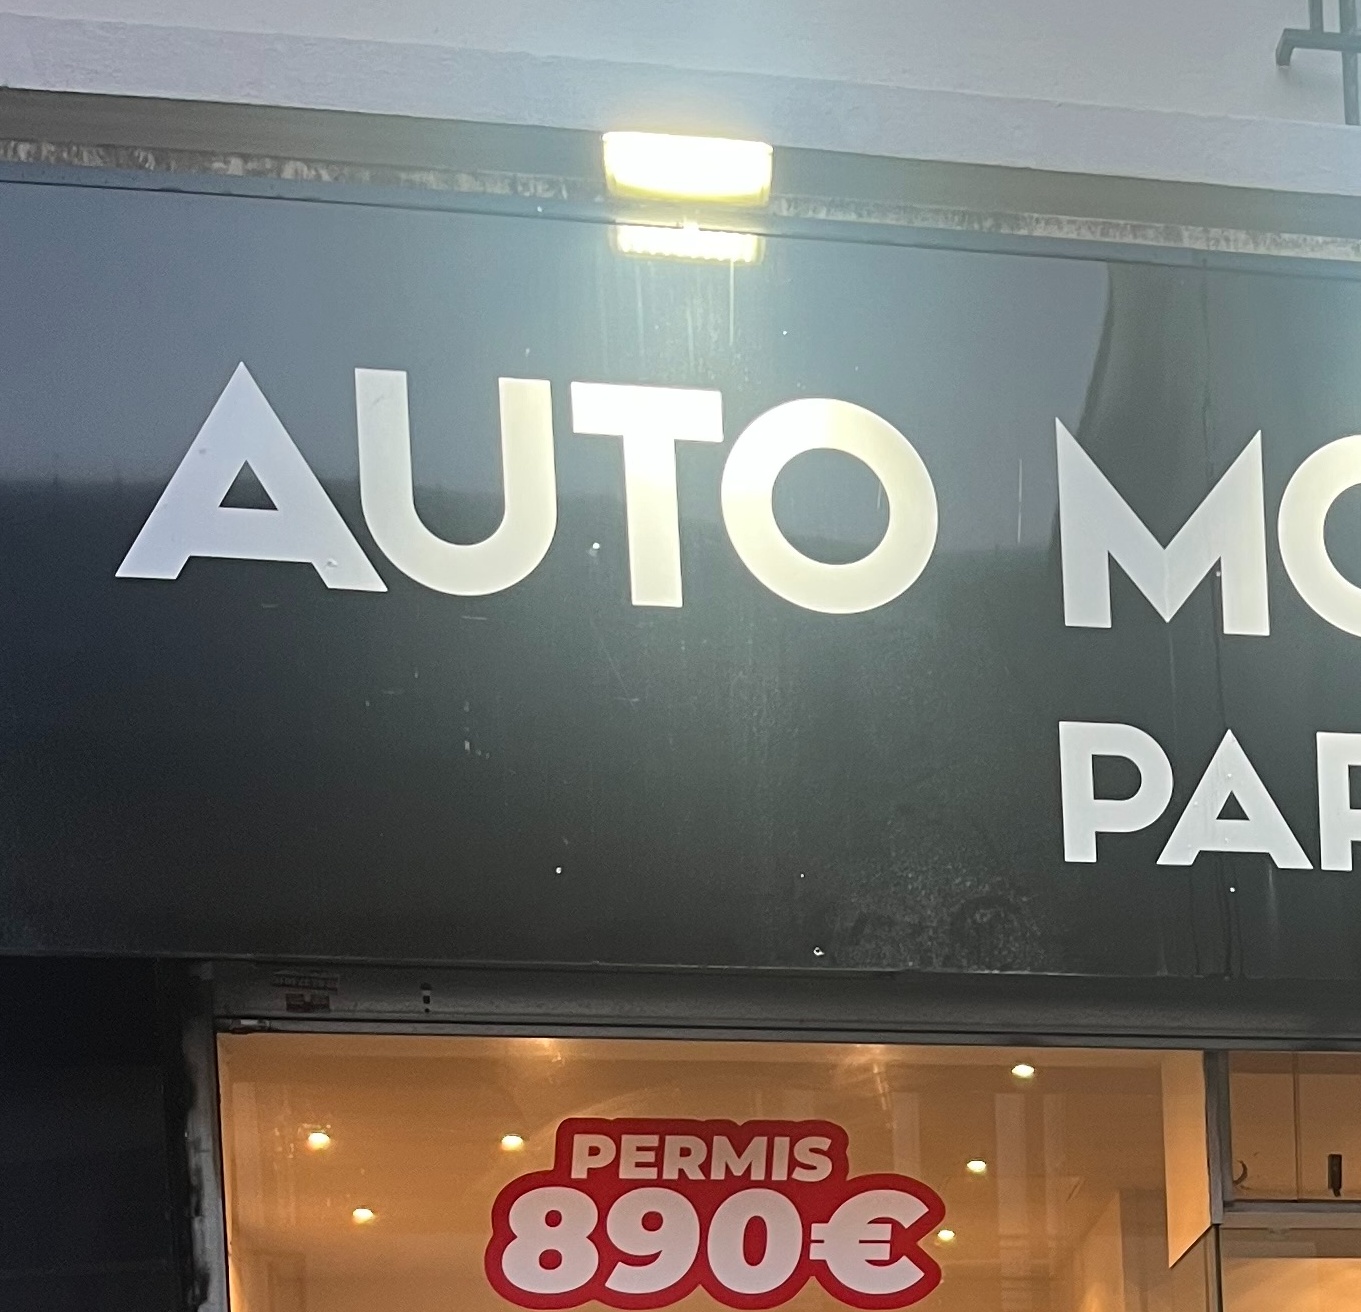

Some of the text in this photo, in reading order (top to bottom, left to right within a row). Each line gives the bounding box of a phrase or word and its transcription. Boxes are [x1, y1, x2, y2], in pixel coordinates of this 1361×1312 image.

[114, 361, 939, 614] AUTO
[571, 1133, 832, 1182] PERMIS
[500, 1186, 930, 1295] 890€
